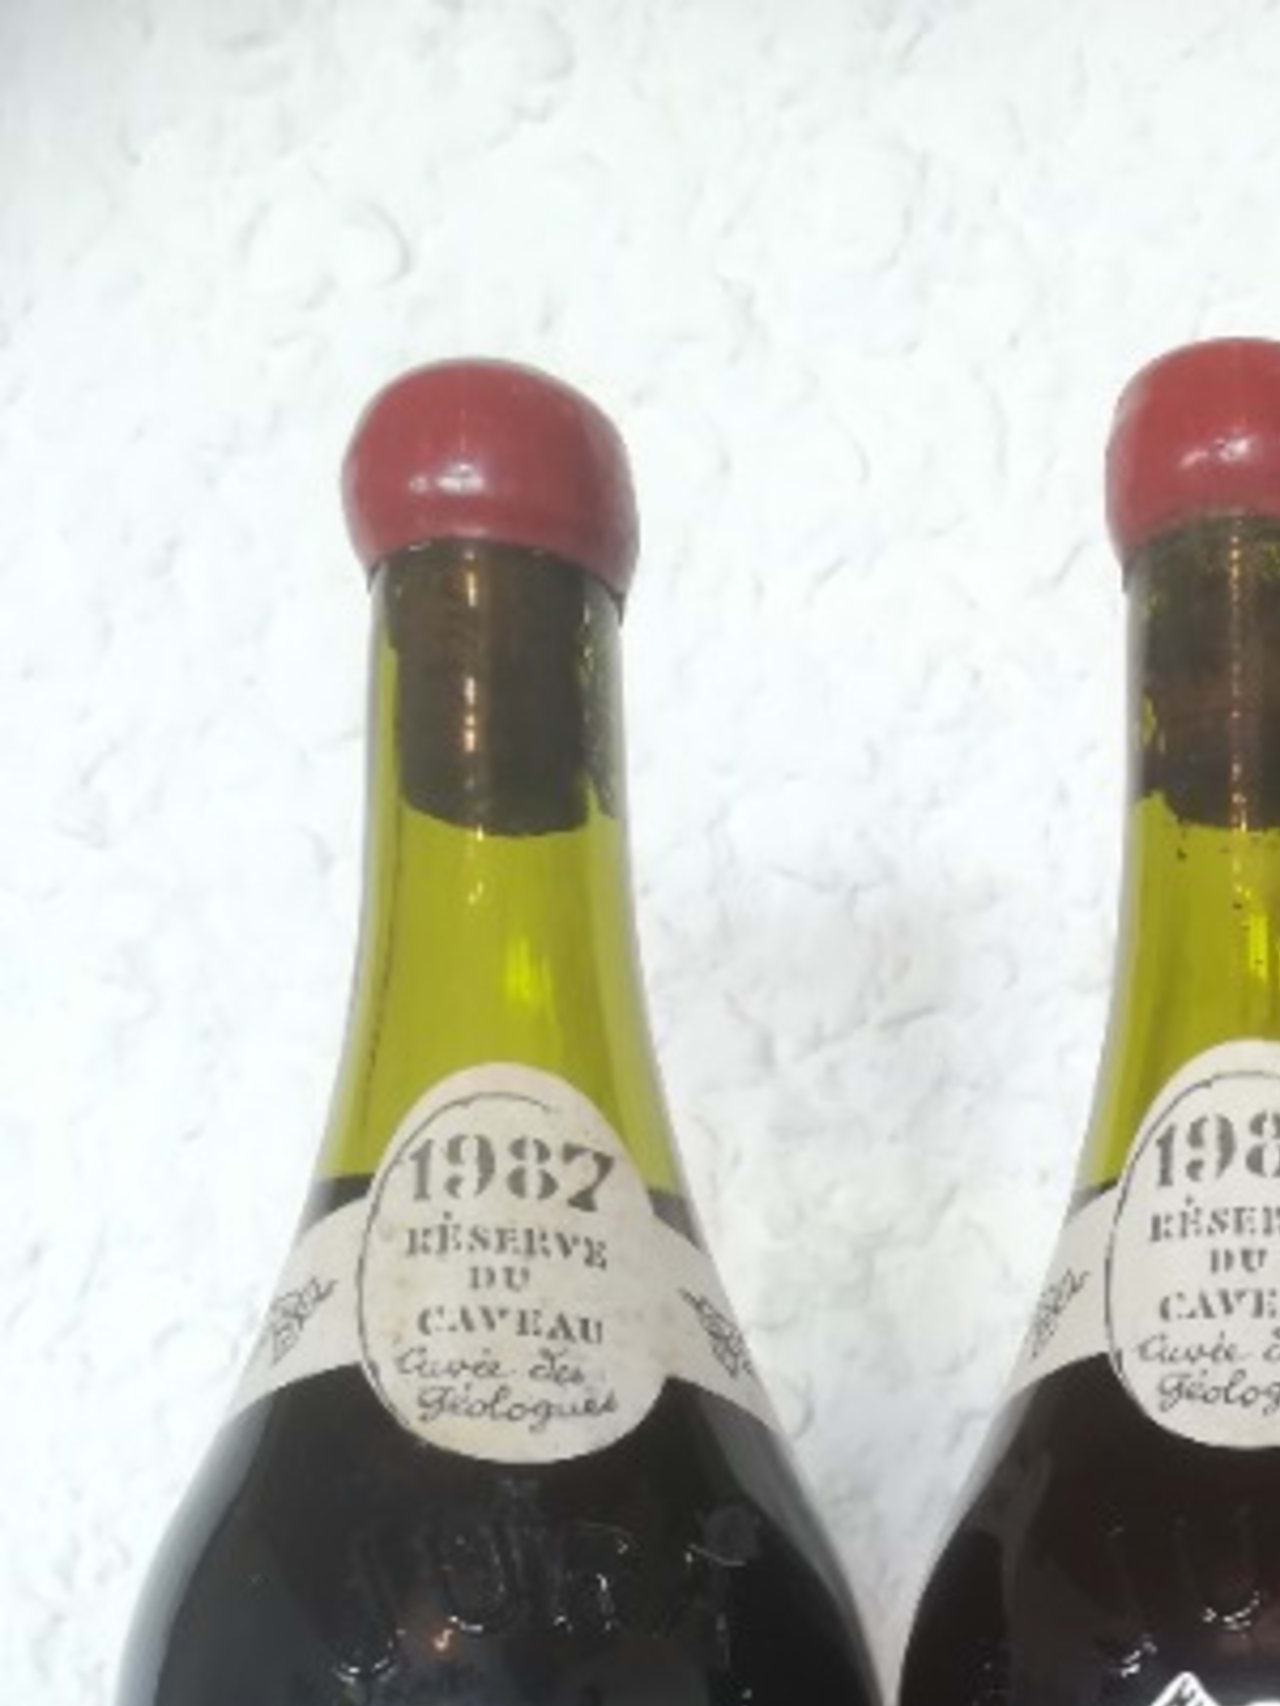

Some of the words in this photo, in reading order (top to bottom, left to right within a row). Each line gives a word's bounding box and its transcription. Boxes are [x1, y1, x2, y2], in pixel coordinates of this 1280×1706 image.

[408, 1133, 615, 1212] 1987
[469, 1266, 530, 1292] DU
[1209, 1248, 1267, 1274] DU
[418, 1305, 604, 1344] CAVEAU
[393, 1343, 510, 1380] Cuvée
[1134, 1330, 1255, 1364] Cuvée
[416, 1385, 618, 1431] Géologues
